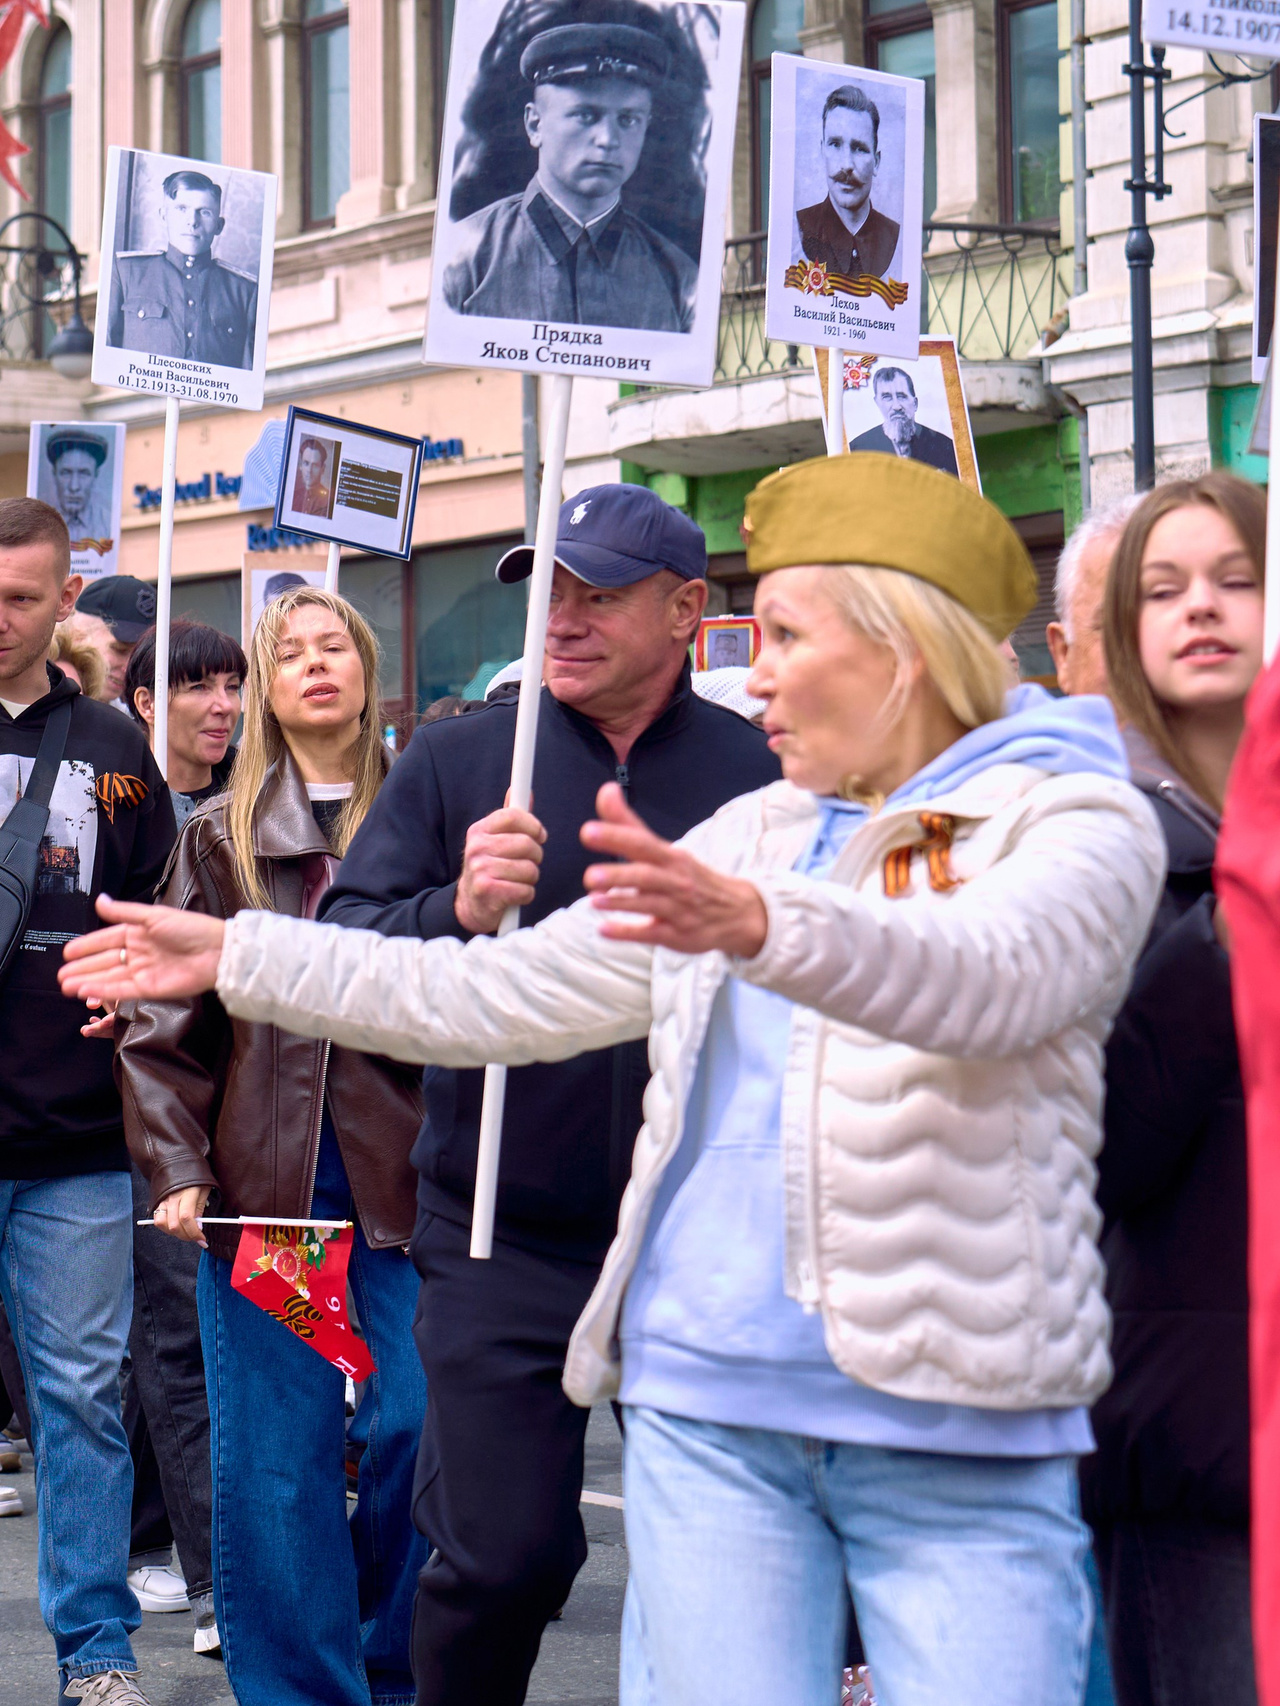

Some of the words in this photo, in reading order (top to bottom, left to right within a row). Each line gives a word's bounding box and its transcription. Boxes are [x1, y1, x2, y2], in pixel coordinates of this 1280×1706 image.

[830, 296, 860, 311] Лехов
[794, 305, 836, 323] Василий
[839, 312, 895, 331] Васильевич
[532, 324, 603, 345] Прядка
[823, 325, 841, 337] 1921
[848, 328, 867, 340] 1960
[148, 354, 212, 374] Плесовских
[480, 342, 529, 361] Яков
[535, 346, 651, 371] Степанович
[129, 364, 162, 379] Роман
[166, 370, 230, 390] Васильевич
[118, 374, 239, 404] 01.12.1913-31.08.1970
